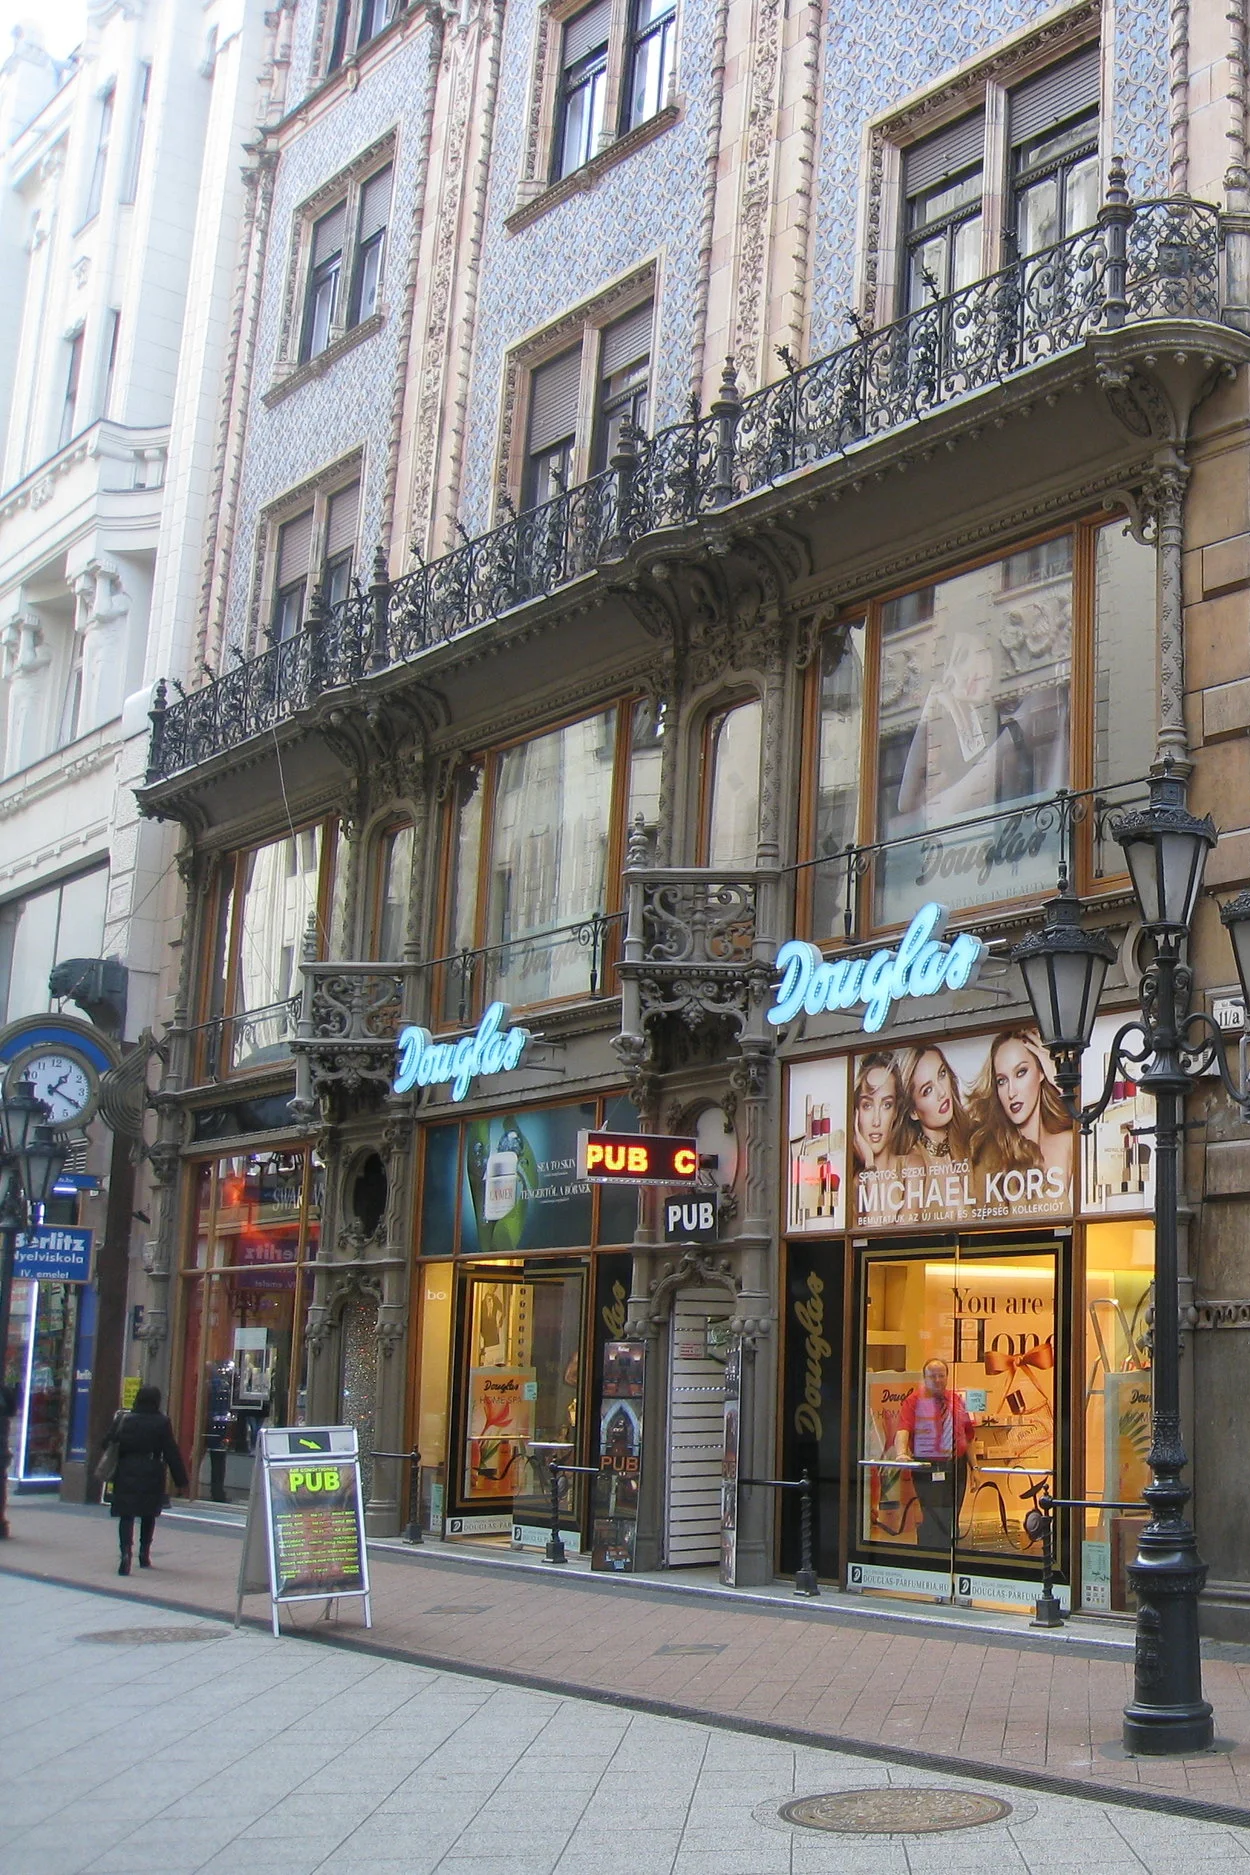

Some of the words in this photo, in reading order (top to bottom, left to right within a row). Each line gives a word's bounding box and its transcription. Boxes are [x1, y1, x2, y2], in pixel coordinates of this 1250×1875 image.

[915, 815, 1047, 887] Douglas
[767, 902, 984, 1034] Douglas
[1218, 1009, 1240, 1027] 11/a
[394, 1002, 527, 1102] Douglas
[587, 1144, 648, 1172] PUB
[858, 1176, 976, 1214] MICHAEL
[985, 1166, 1065, 1204] KORS
[668, 1202, 714, 1232] PUB
[908, 1213, 919, 1223] AZ
[933, 1211, 953, 1221] ILLAT
[950, 1287, 998, 1316] You
[1005, 1297, 1044, 1316] are
[794, 1271, 832, 1441] Douglas
[600, 1456, 638, 1471] PUB
[289, 1472, 340, 1492] PUB
